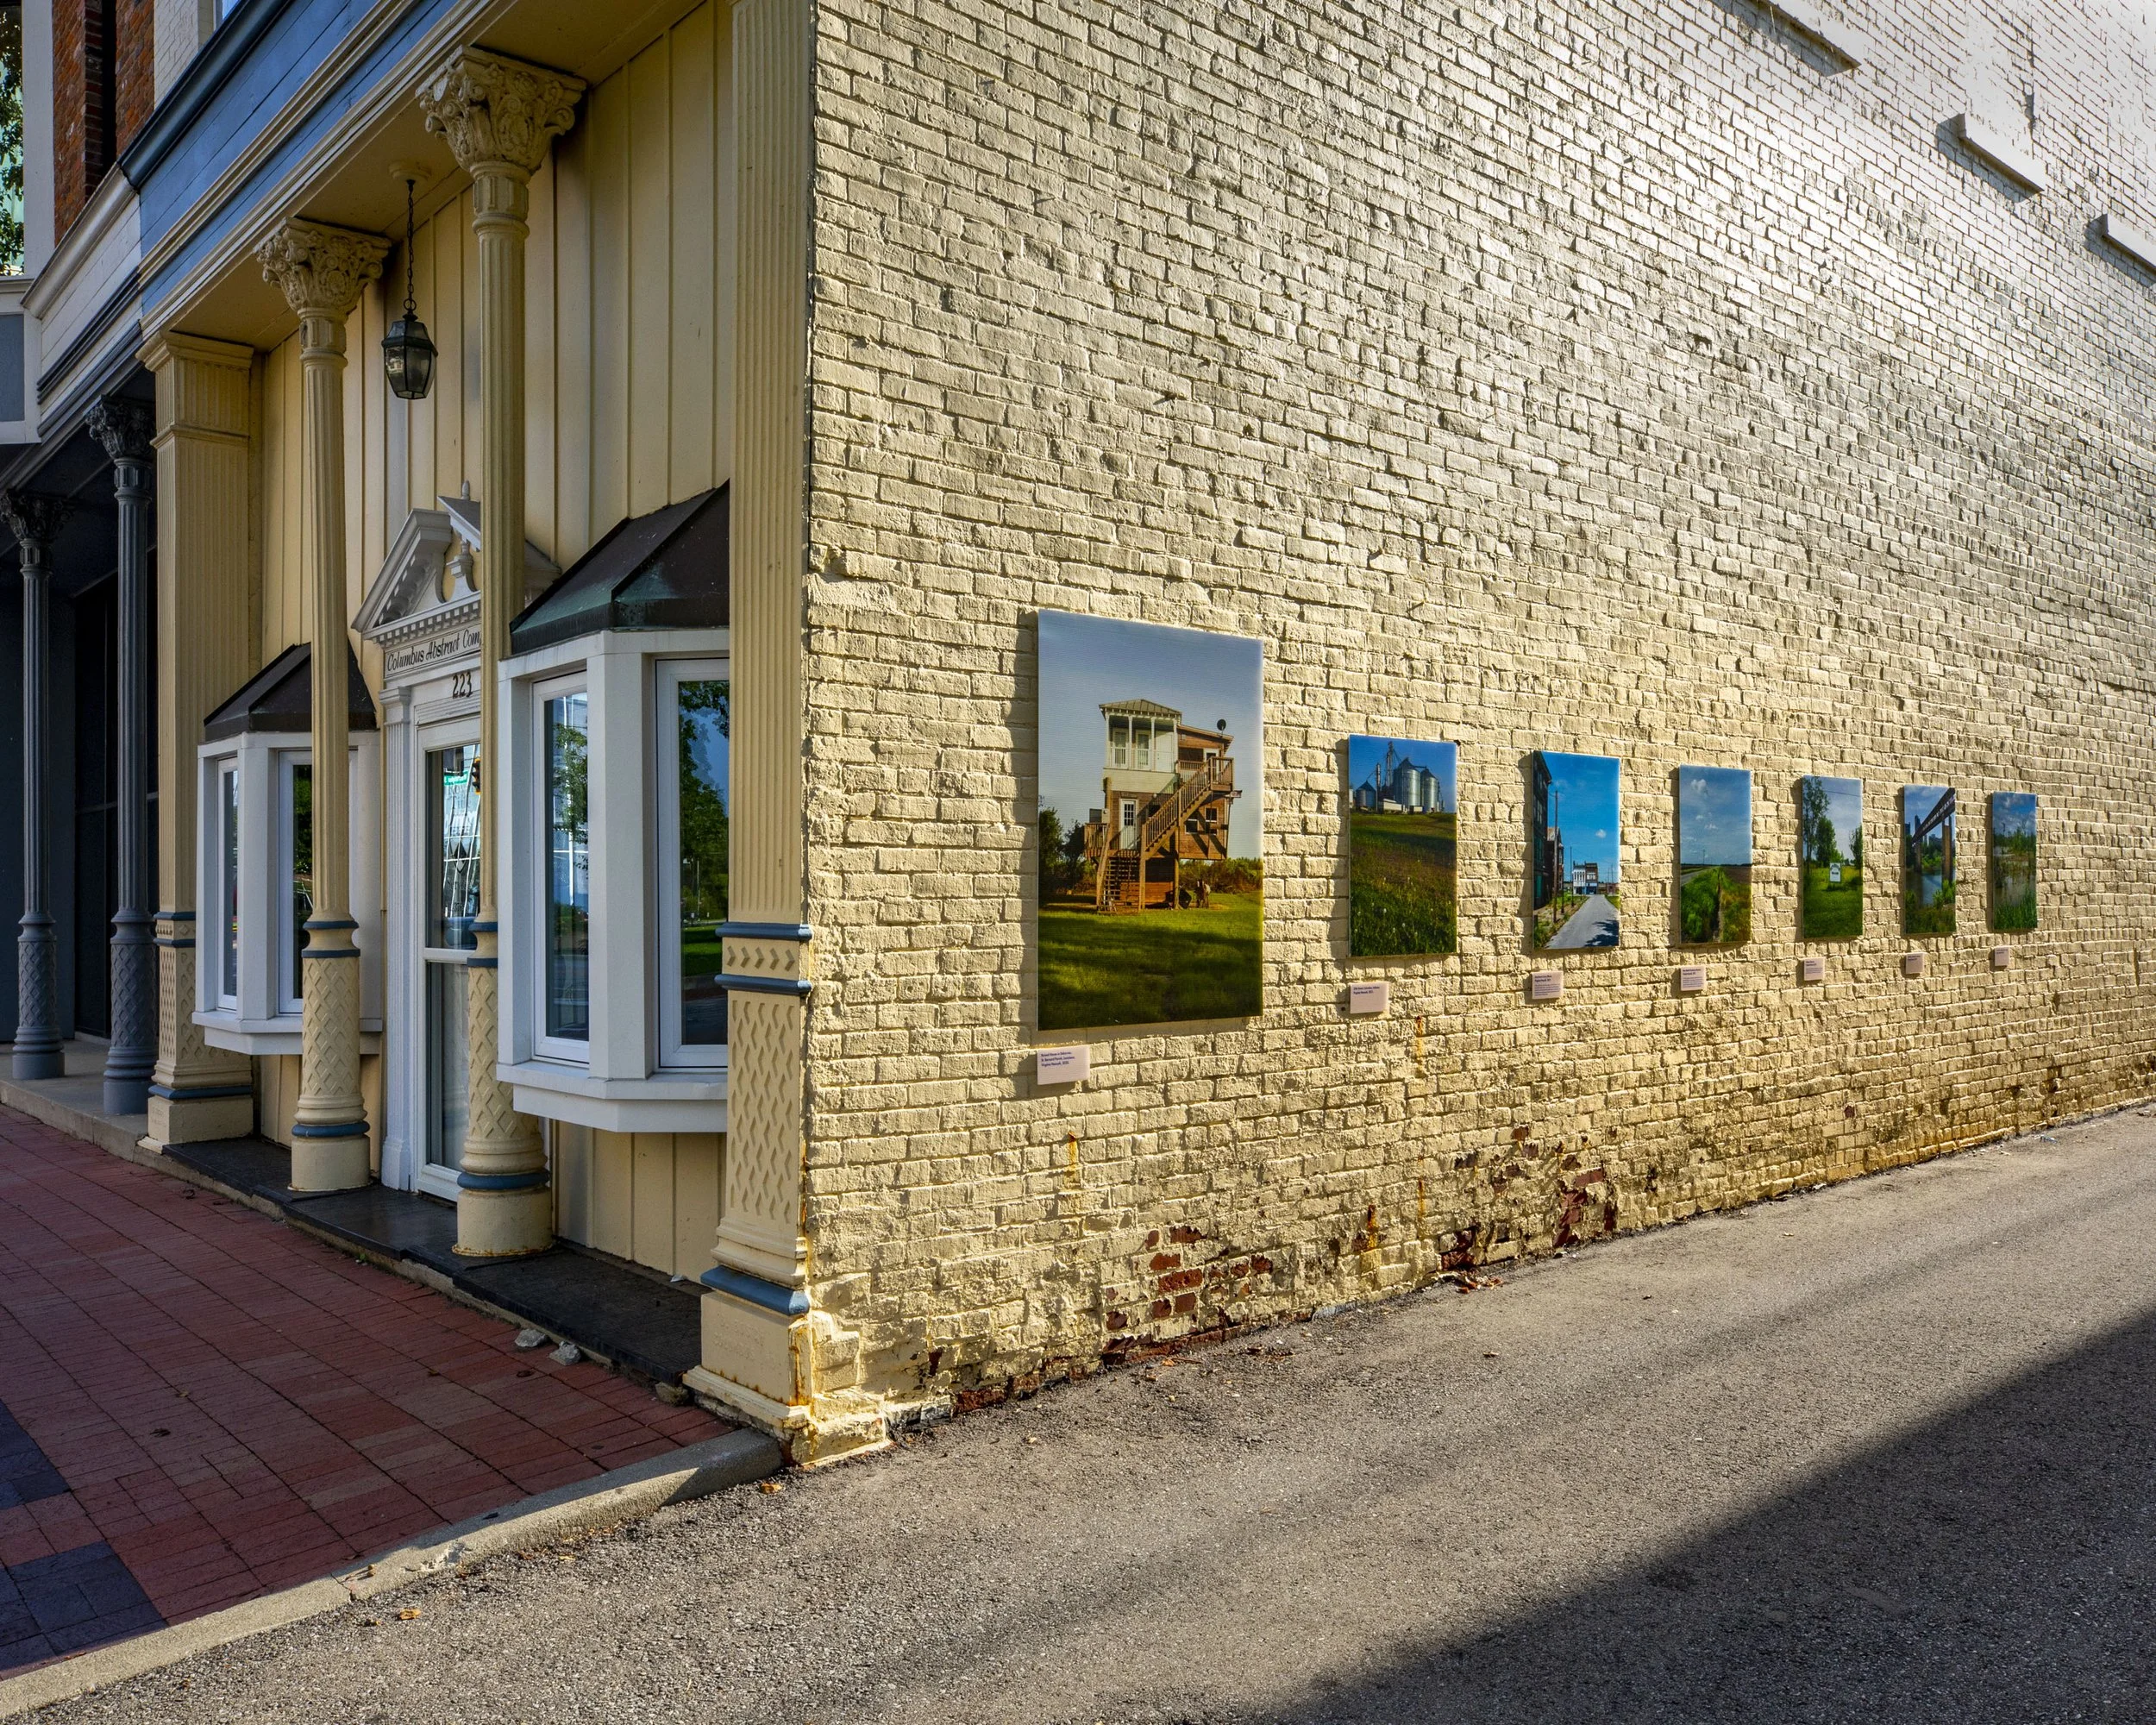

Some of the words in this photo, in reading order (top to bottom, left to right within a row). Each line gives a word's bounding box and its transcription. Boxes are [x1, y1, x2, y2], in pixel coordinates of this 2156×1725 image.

[387, 646, 424, 671] Columbus
[425, 632, 461, 661] Abstract
[452, 672, 473, 699] 223
